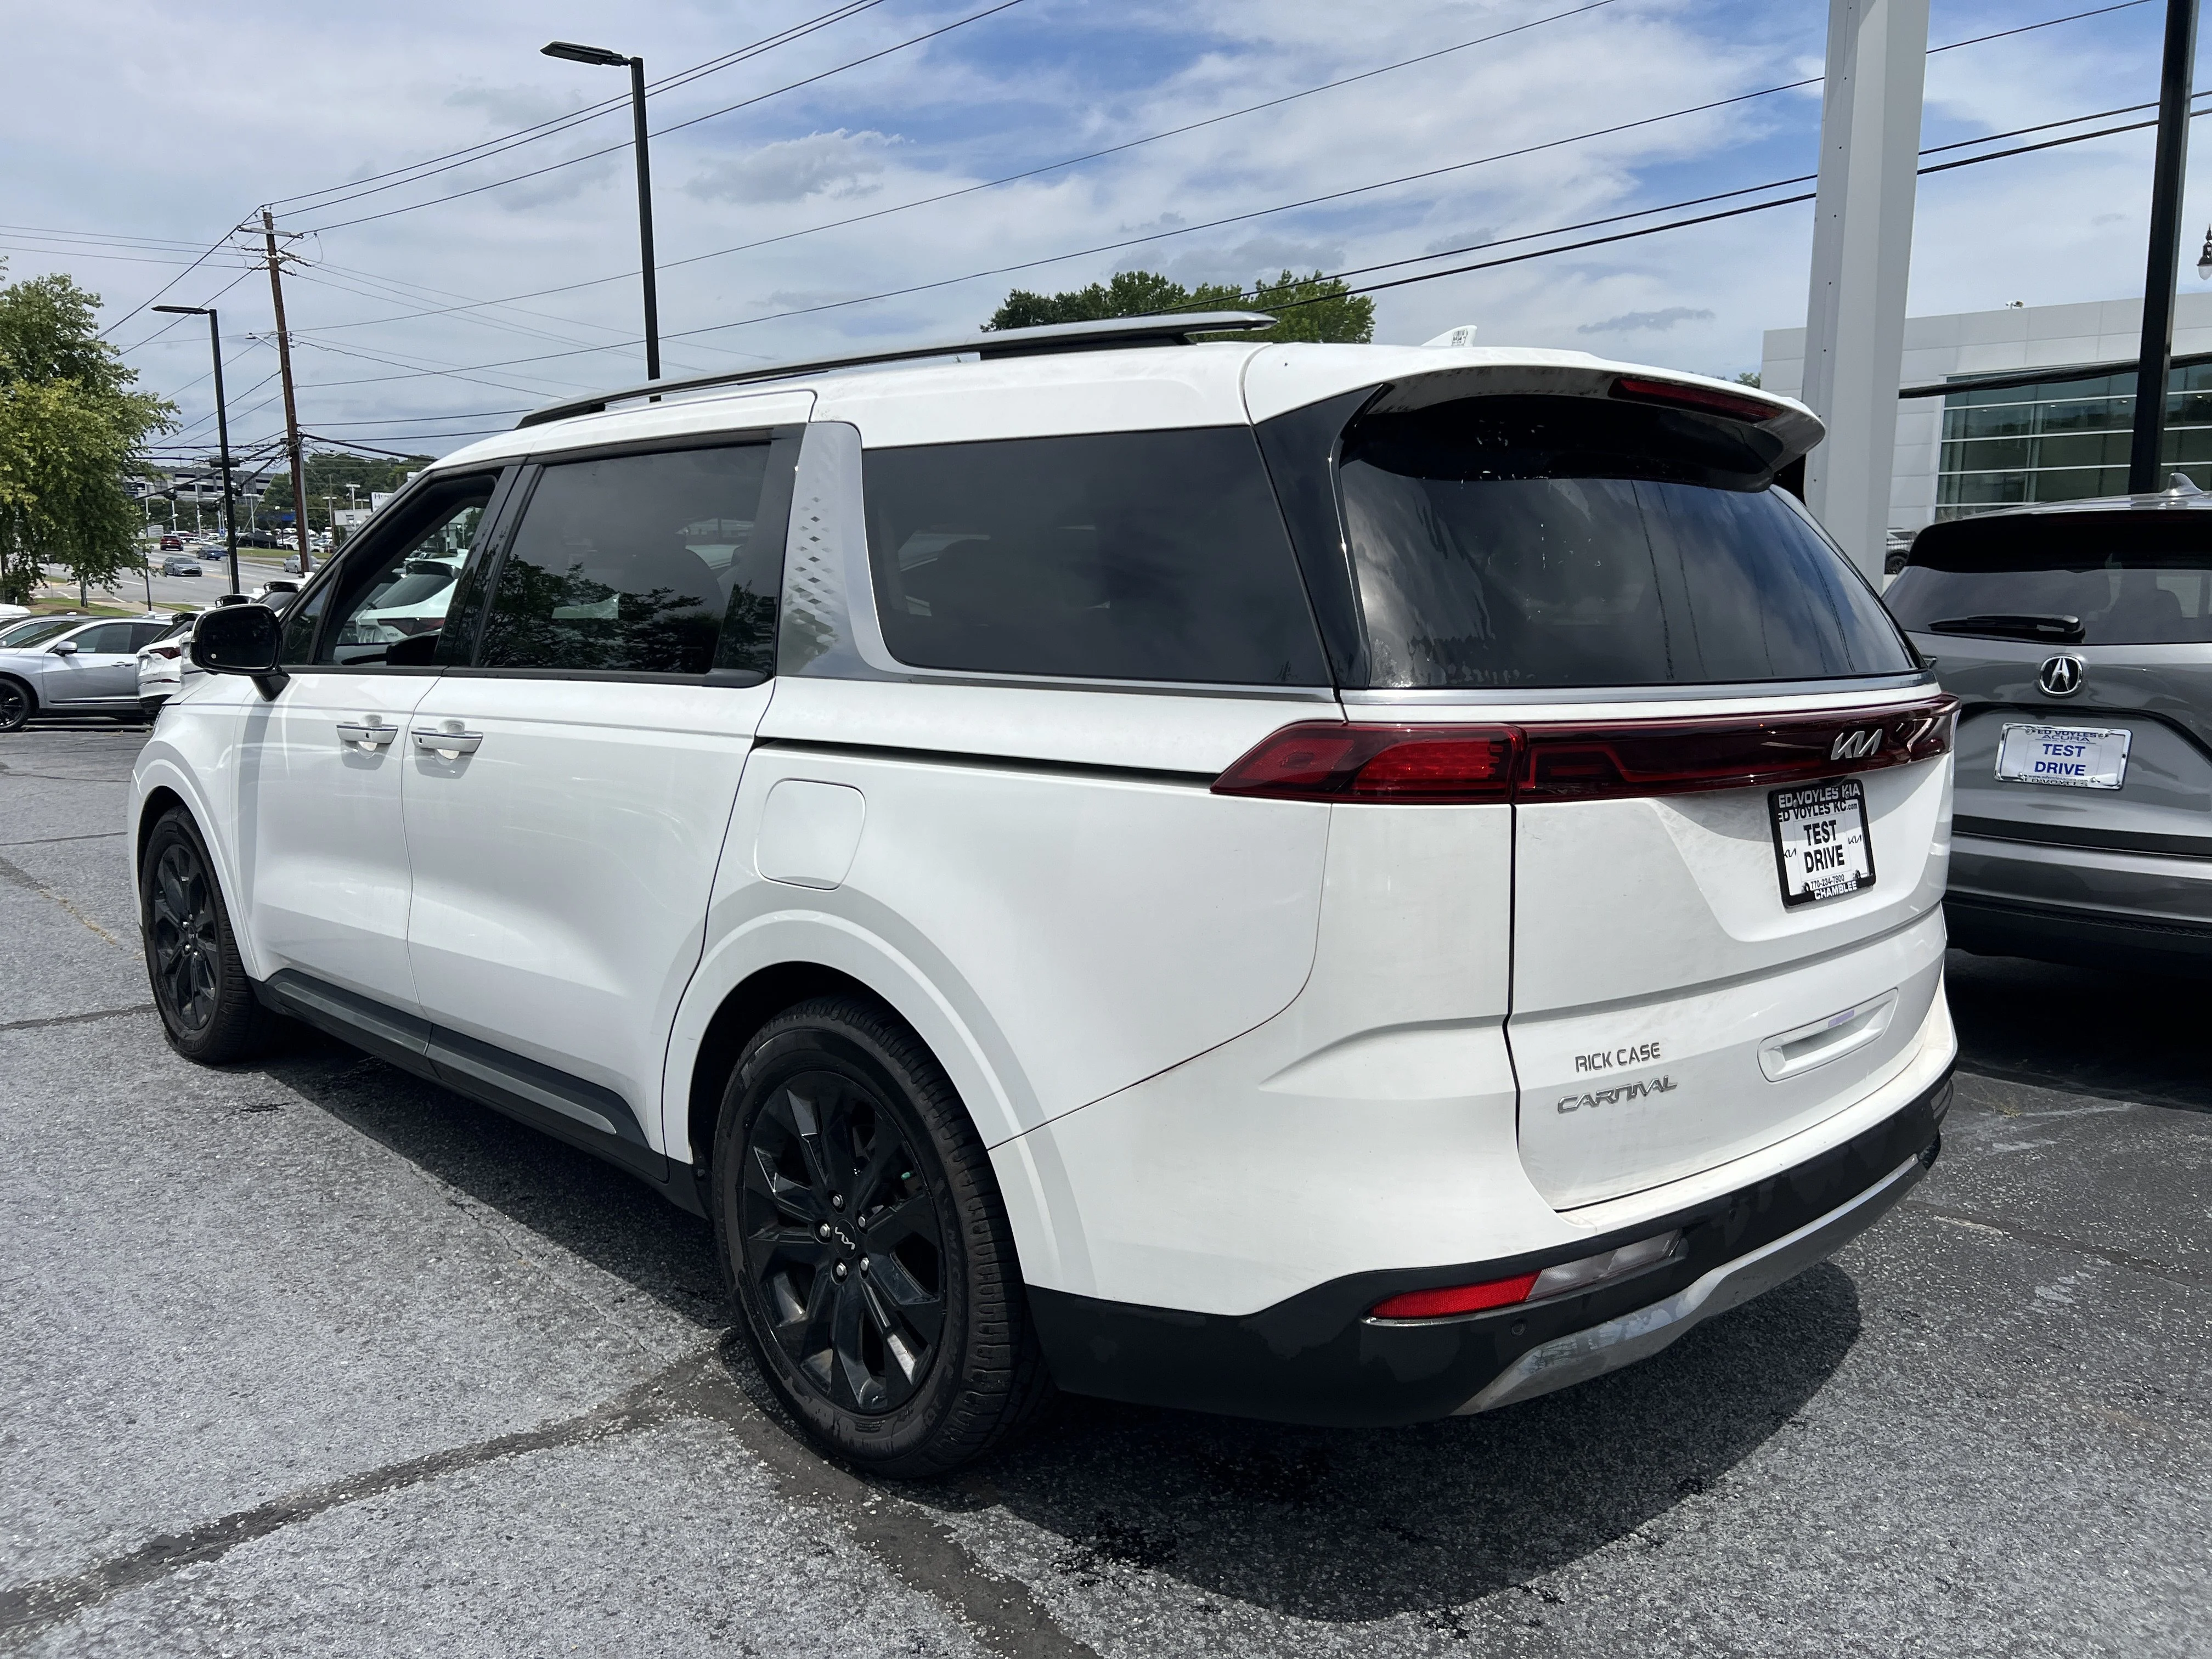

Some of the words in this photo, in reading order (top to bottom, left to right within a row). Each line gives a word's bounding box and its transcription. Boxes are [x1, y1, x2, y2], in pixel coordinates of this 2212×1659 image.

[1830, 729, 1883, 760] KIA
[2042, 743, 2086, 757] TEST
[2034, 761, 2086, 776] DRIVE
[1779, 793, 1793, 808] ED
[1796, 787, 1839, 805] VOYLES
[1842, 783, 1860, 798] KIA
[1778, 810, 1790, 822] ED
[1793, 803, 1831, 820] VOYLES
[1803, 820, 1837, 846] TEST
[1803, 845, 1845, 874] DRIVE
[1814, 880, 1858, 900] CHAMBLEE
[1575, 1051, 1613, 1073] RICK
[1617, 1042, 1661, 1066] CASE
[1558, 1075, 1678, 1114] CARNIVAL
